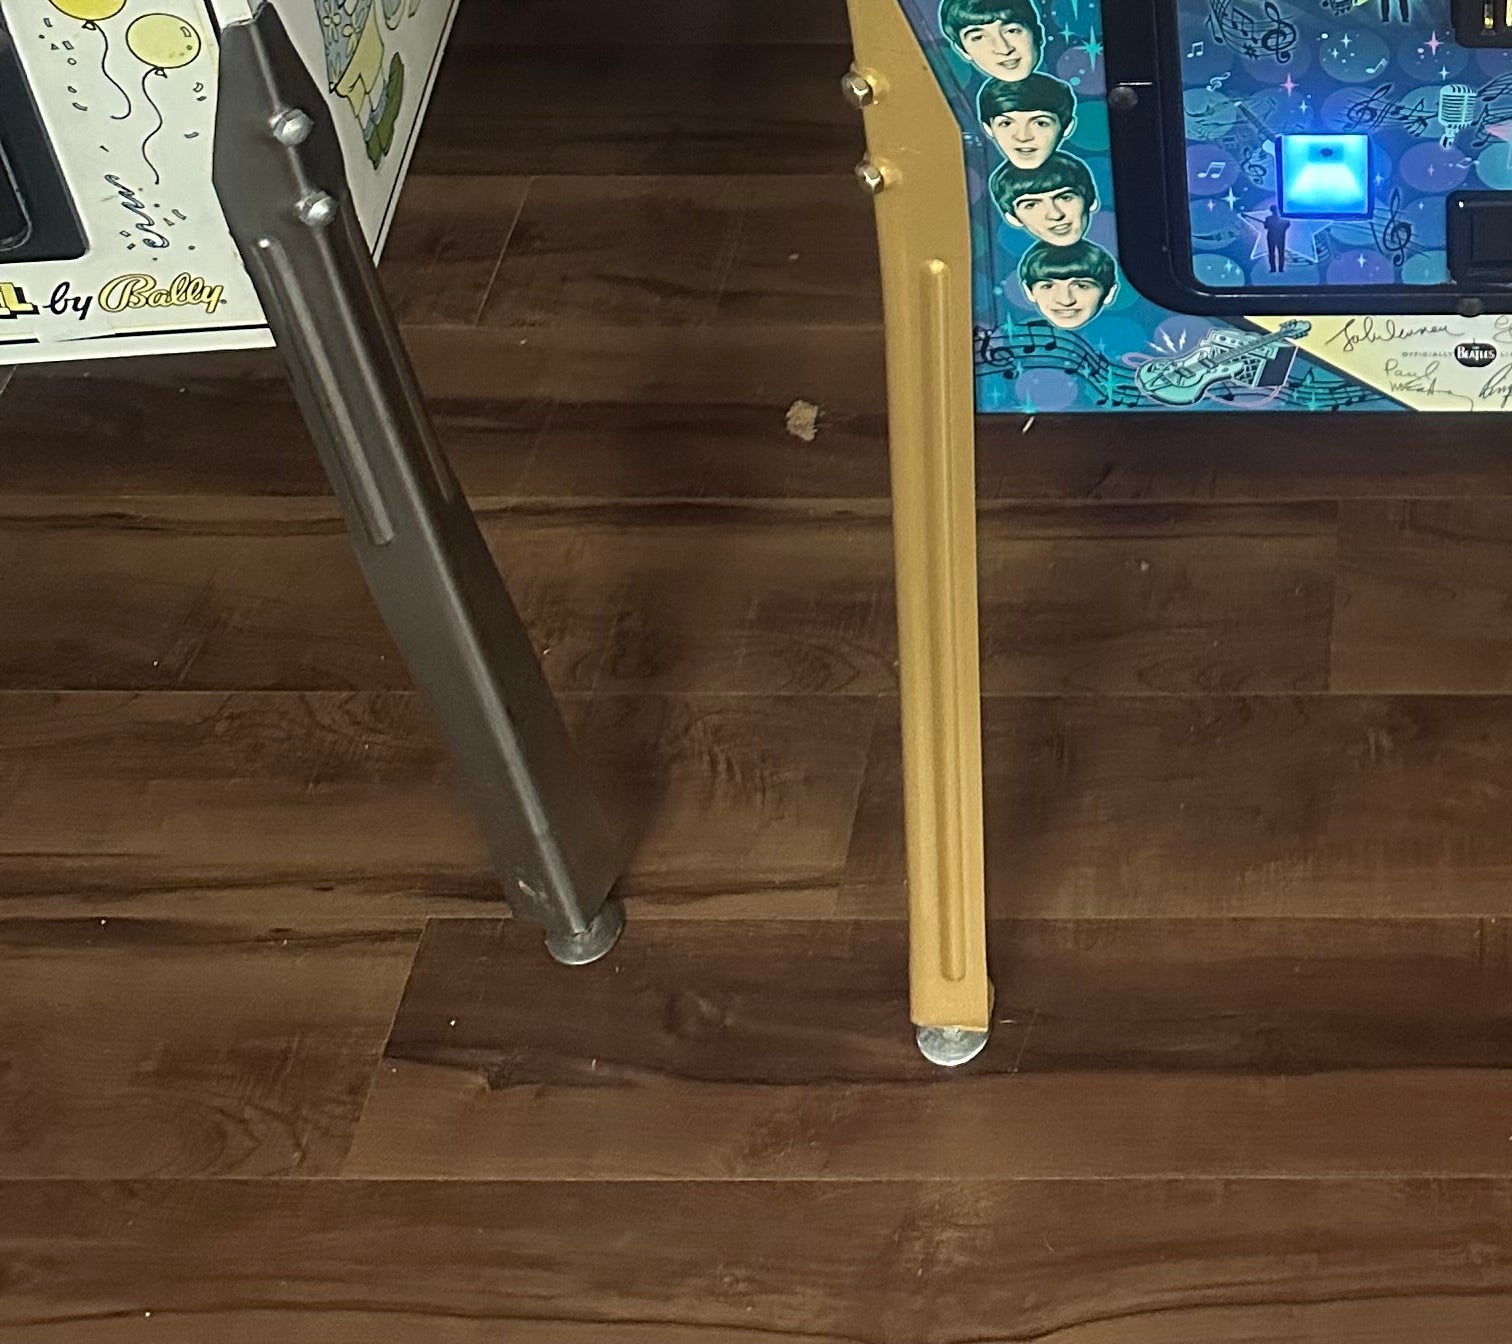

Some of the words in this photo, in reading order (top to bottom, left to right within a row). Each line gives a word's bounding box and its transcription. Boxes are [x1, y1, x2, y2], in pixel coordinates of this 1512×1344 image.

[43, 281, 94, 321] by
[97, 271, 225, 314] Bally
[1456, 345, 1496, 363] BEATLES
